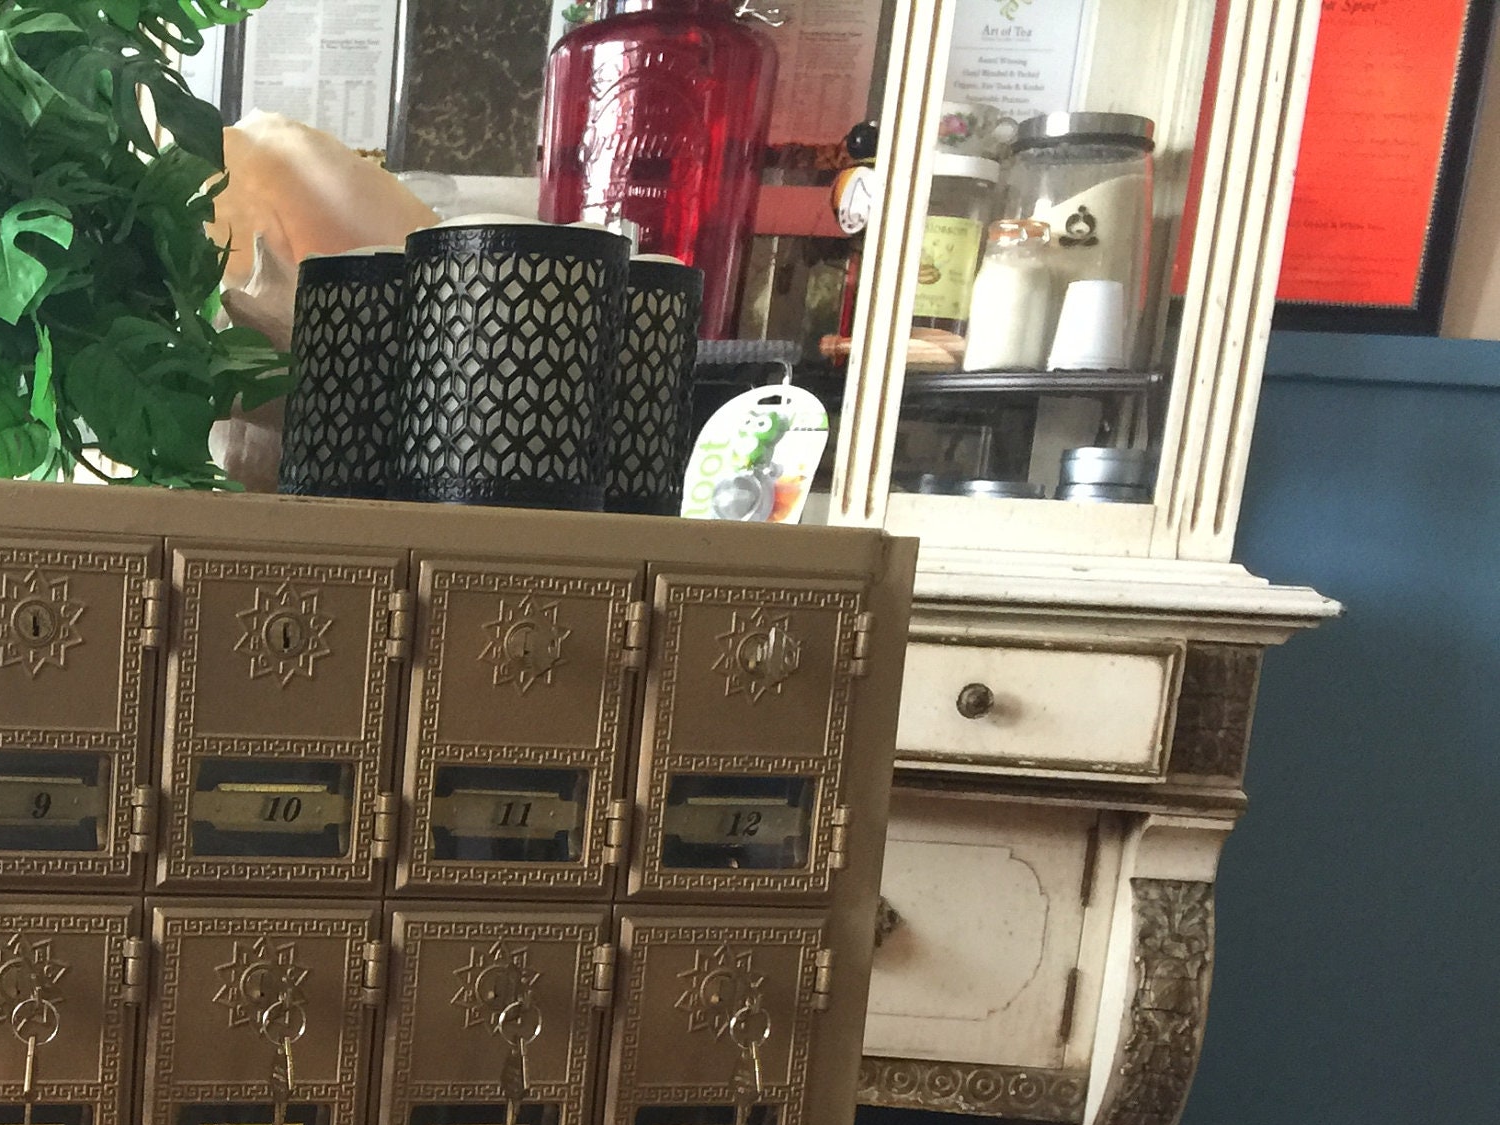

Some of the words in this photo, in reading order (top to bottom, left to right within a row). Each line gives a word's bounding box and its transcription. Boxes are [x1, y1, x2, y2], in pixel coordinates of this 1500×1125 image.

[1014, 26, 1032, 37] Tea
[31, 792, 52, 818] 9
[264, 797, 302, 823] 10
[498, 802, 534, 828] 11
[726, 811, 762, 837] 12
